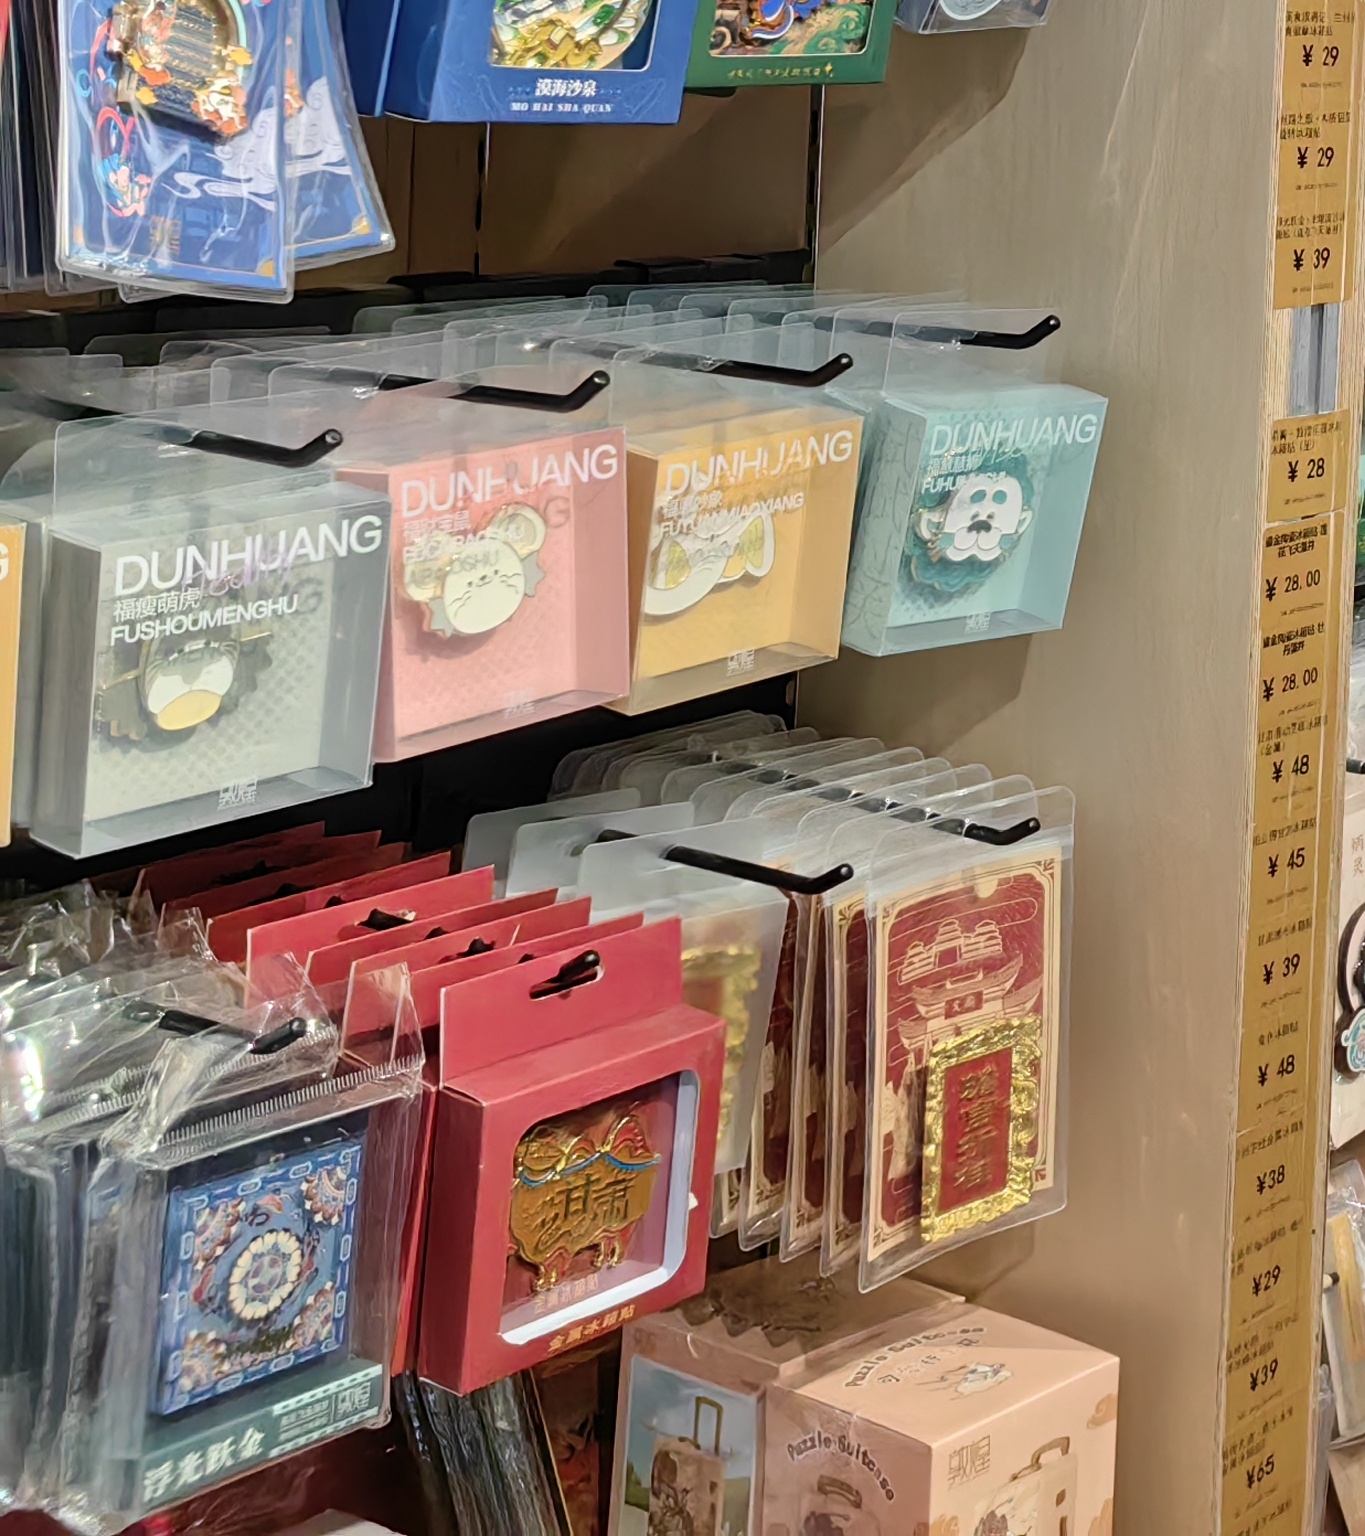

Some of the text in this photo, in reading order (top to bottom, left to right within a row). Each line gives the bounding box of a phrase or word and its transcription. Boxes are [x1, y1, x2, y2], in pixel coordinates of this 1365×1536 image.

[1322, 46, 1340, 66] 29
[1317, 146, 1334, 167] 29
[1312, 247, 1331, 269] 39
[930, 413, 1099, 456] DUNHUANG
[665, 430, 854, 496] DUNHUANG
[1307, 457, 1325, 479] 28
[402, 444, 619, 519] DUNHUANG
[115, 514, 383, 597] DUNHUANG
[110, 594, 299, 647] FUSHOUMENGHU
[1291, 754, 1310, 776] 48
[1287, 847, 1305, 869] 45
[1282, 953, 1300, 976] 39
[1276, 1054, 1295, 1078] 48
